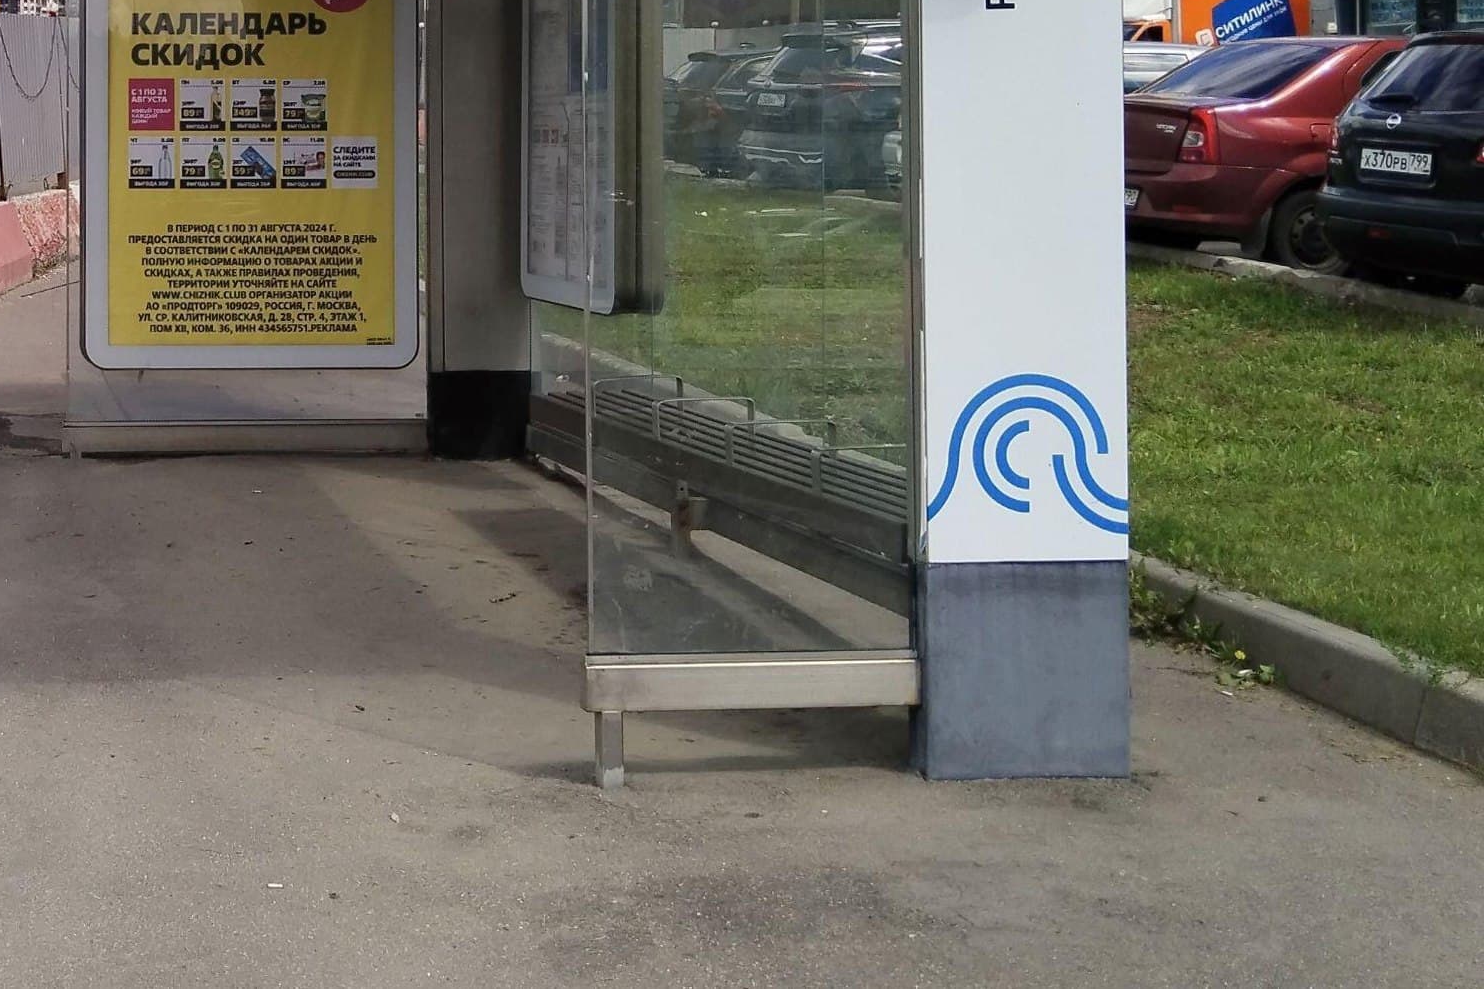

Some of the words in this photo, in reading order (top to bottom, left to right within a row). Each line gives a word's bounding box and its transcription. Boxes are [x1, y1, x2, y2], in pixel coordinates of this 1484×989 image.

[131, 12, 327, 39] КАЛЕНДАРЬ
[131, 43, 265, 71] СКИДОК
[333, 146, 375, 155] СЛЕДИТЕ
[1410, 154, 1429, 167] 799
[176, 225, 215, 233] ПЕРИОД
[260, 224, 302, 232] АВГУСТА
[303, 224, 327, 232] 2024
[329, 224, 336, 232] Г.
[128, 235, 221, 244] ПРЕДОСТАВЛЯЕТСЯ
[223, 235, 263, 244] СКИДКА
[265, 235, 278, 243] НА
[280, 235, 308, 244] ОДИН
[311, 235, 342, 243] ТОВАР
[344, 235, 350, 243] В
[352, 235, 377, 244] ДЕНЬ
[154, 247, 228, 255] СООТВЕТСТВИИ
[238, 246, 310, 255] «КАЛЕНДАРЕМ
[312, 246, 360, 255] СКИДОК».
[187, 258, 261, 267] ИНФОРМАЦИЮ
[273, 257, 317, 265] ТОВАРАХ
[319, 257, 353, 267] АКЦИИ
[356, 257, 362, 265] И
[144, 269, 193, 278] СКИДКАХ,
[196, 269, 202, 277] А
[204, 269, 237, 277] ТАКЖЕ
[239, 269, 290, 277] ПРАВИЛАХ
[293, 268, 360, 278] ПРОВЕДЕНИЯ,
[168, 280, 230, 288] ТЕРРИТОРИИ
[233, 278, 288, 288] УТОЧНЯЙТЕ
[291, 280, 304, 288] НА
[307, 278, 336, 288] САЙТЕ
[152, 291, 246, 299] WWW.CHIZHIK.CLUB
[249, 291, 316, 299] ОРГАНИЗАТОР
[318, 291, 352, 300] АКЦИИ
[146, 302, 160, 310] АО
[162, 302, 222, 311] «ПРОДТОРГ»
[226, 302, 262, 311] 109029,
[265, 302, 305, 311] РОССИЯ,
[308, 302, 315, 310] Г.
[317, 302, 361, 311] МОСКВА,
[138, 313, 152, 321] УЛ.
[156, 313, 169, 321] СР.
[172, 313, 266, 323] КАЛИТНИКОВСКАЯ,
[268, 313, 278, 323] Д.
[281, 313, 295, 322] 28,
[297, 313, 316, 321] СТР.
[319, 313, 328, 322] 4,
[330, 313, 356, 321] ЭТАЖ
[359, 313, 367, 322] 1,
[219, 325, 233, 334] 36,
[236, 324, 256, 332] ИНН
